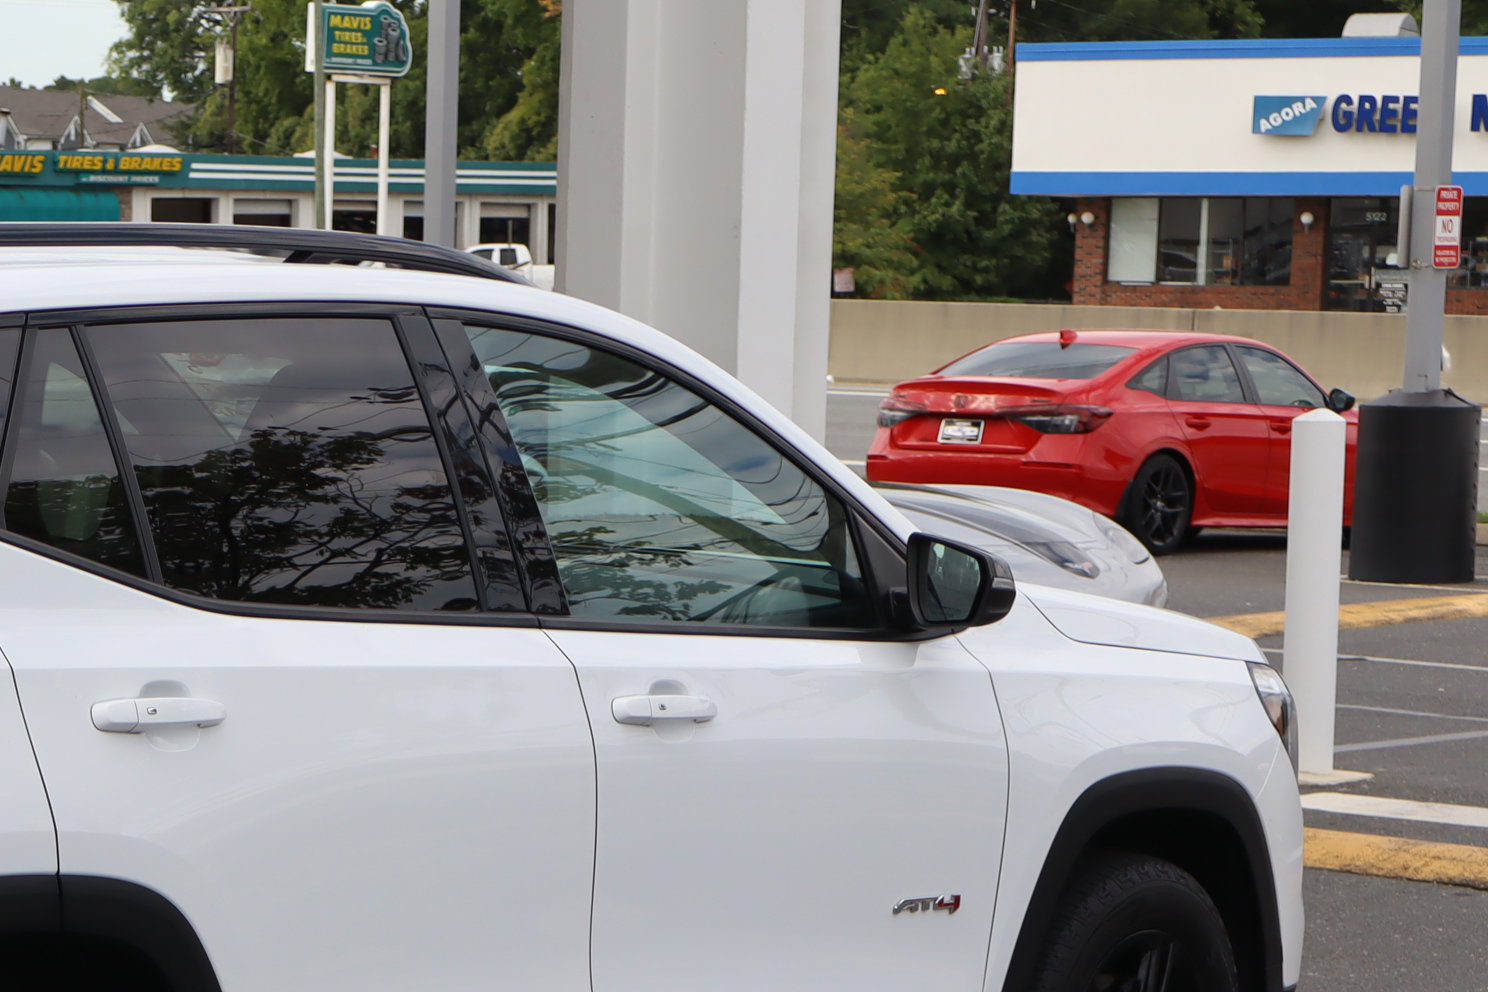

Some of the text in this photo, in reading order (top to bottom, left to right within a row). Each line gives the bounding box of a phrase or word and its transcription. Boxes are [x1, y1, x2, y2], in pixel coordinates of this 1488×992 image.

[329, 14, 372, 30] MAVIS
[332, 43, 369, 55] BRAKES
[1258, 94, 1419, 133] AGORA GREE
[58, 155, 104, 170] TIRES
[106, 157, 115, 170] &
[119, 156, 183, 171] BRAKES
[1441, 218, 1455, 234] NO
[893, 893, 961, 915] AT4
